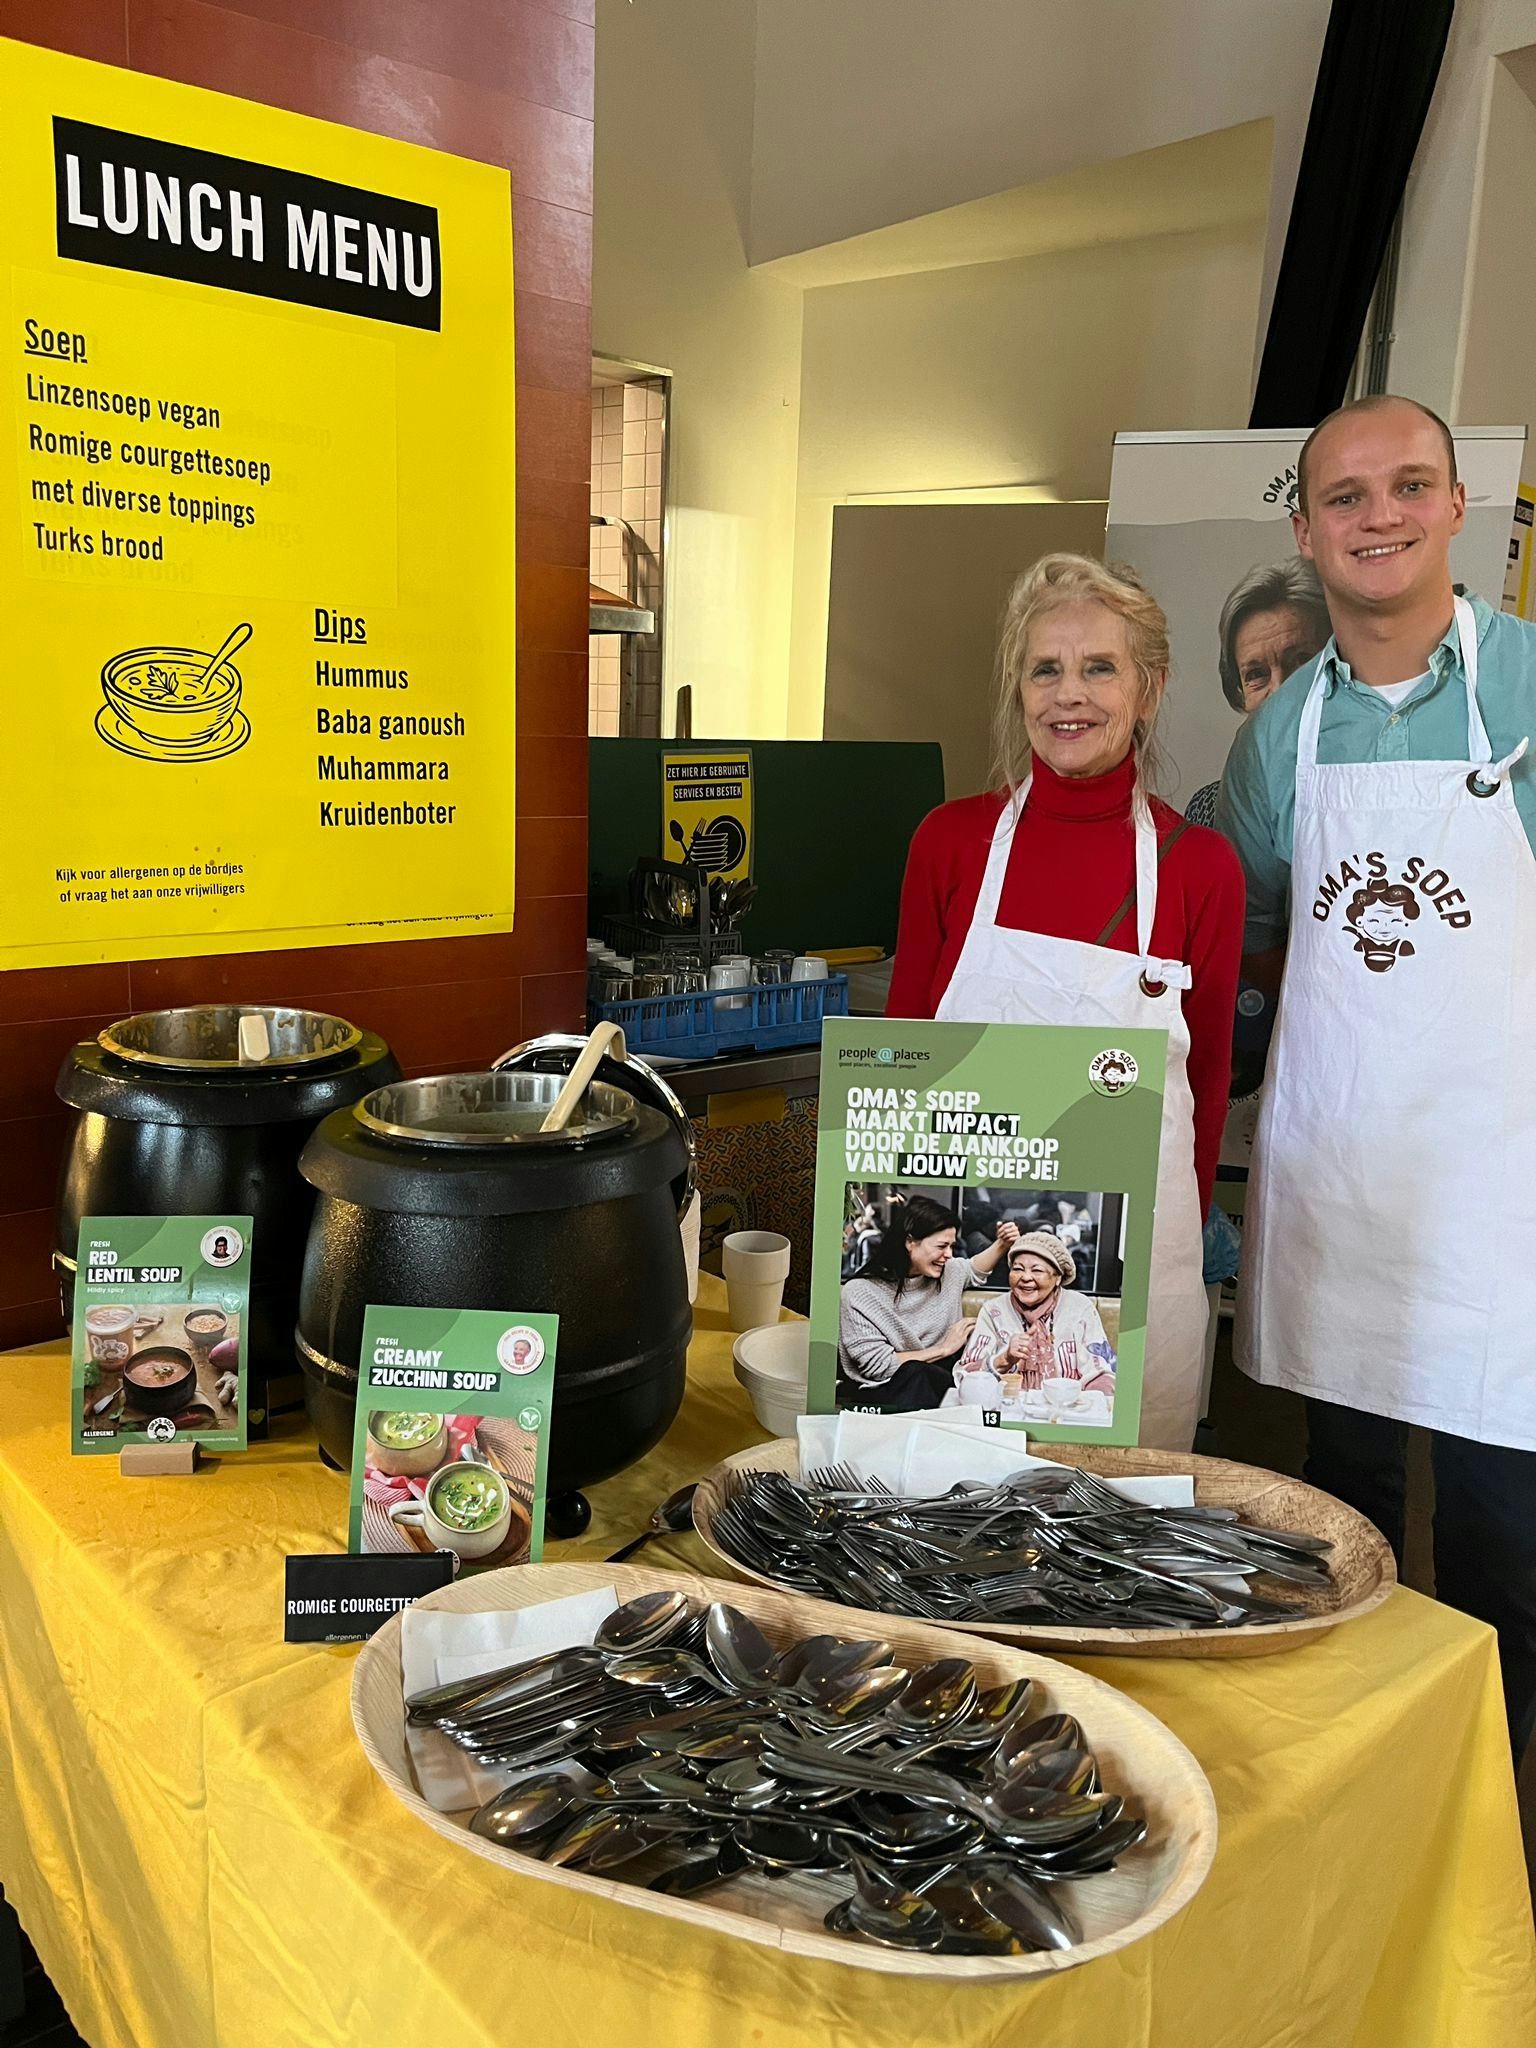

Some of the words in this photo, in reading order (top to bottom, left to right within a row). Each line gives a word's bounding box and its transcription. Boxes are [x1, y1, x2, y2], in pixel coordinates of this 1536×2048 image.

[66, 153, 264, 262] LUNCH
[287, 203, 433, 298] MENU
[24, 318, 88, 362] Soep
[26, 373, 152, 422] Linzensoep
[158, 399, 221, 429] vegan
[29, 423, 113, 462] Romige
[121, 443, 272, 485] courgettesoep
[1263, 465, 1296, 503] OMA'
[32, 477, 75, 505] met
[82, 482, 162, 514] diverse
[169, 492, 256, 527] toppings
[33, 523, 95, 554] Turks
[102, 529, 164, 561] brood
[314, 608, 367, 644] Dips
[316, 660, 409, 690] Hummus
[317, 708, 372, 735] Baba
[378, 712, 466, 740] ganoush
[318, 755, 450, 781] Muhammara
[667, 768, 680, 779] ZET
[682, 767, 699, 778] HIER
[700, 766, 708, 777] JE
[709, 764, 746, 777] GEBRUIKTE
[674, 787, 704, 799] SERVIES
[705, 787, 714, 798] EN
[716, 786, 742, 797] BESTEK
[320, 801, 457, 828] Kruidenboter
[56, 868, 77, 882] Kijk
[80, 870, 107, 880] voor
[110, 866, 170, 880] allergenen
[173, 867, 187, 878] op
[188, 863, 202, 876] de
[205, 863, 244, 877] bordjes
[59, 888, 72, 902] of
[74, 890, 108, 902] vraag
[111, 886, 130, 899] het
[132, 888, 153, 898] aan
[156, 887, 182, 897] onze
[185, 884, 245, 897] vrijwilligers
[1312, 850, 1388, 922] OMA'S
[1401, 855, 1472, 931] SOEP
[1092, 1050, 1116, 1071] OMA'S
[1119, 1052, 1136, 1073] SOEP
[847, 1087, 917, 1110] OMA'S
[926, 1091, 981, 1112] SOEP
[846, 1109, 928, 1131] MAAKT
[935, 1112, 1020, 1136] IMPACT
[845, 1130, 904, 1153] DOOR
[913, 1132, 939, 1153] DE
[949, 1133, 1059, 1158] AANKOOP
[845, 1152, 894, 1174] VAN
[901, 1154, 967, 1177] JOUW
[90, 1240, 110, 1248] FRESH
[89, 1251, 118, 1266] RED
[87, 1268, 135, 1283] LENTIL
[140, 1267, 180, 1283] SOUP
[376, 1337, 398, 1346] FRESH
[373, 1348, 443, 1367] CREAMY
[372, 1369, 448, 1388] ZUCCHINI
[453, 1372, 498, 1390] SOUP
[83, 1430, 114, 1438] ALLERGENS
[288, 1599, 336, 1615] ROMIGE
